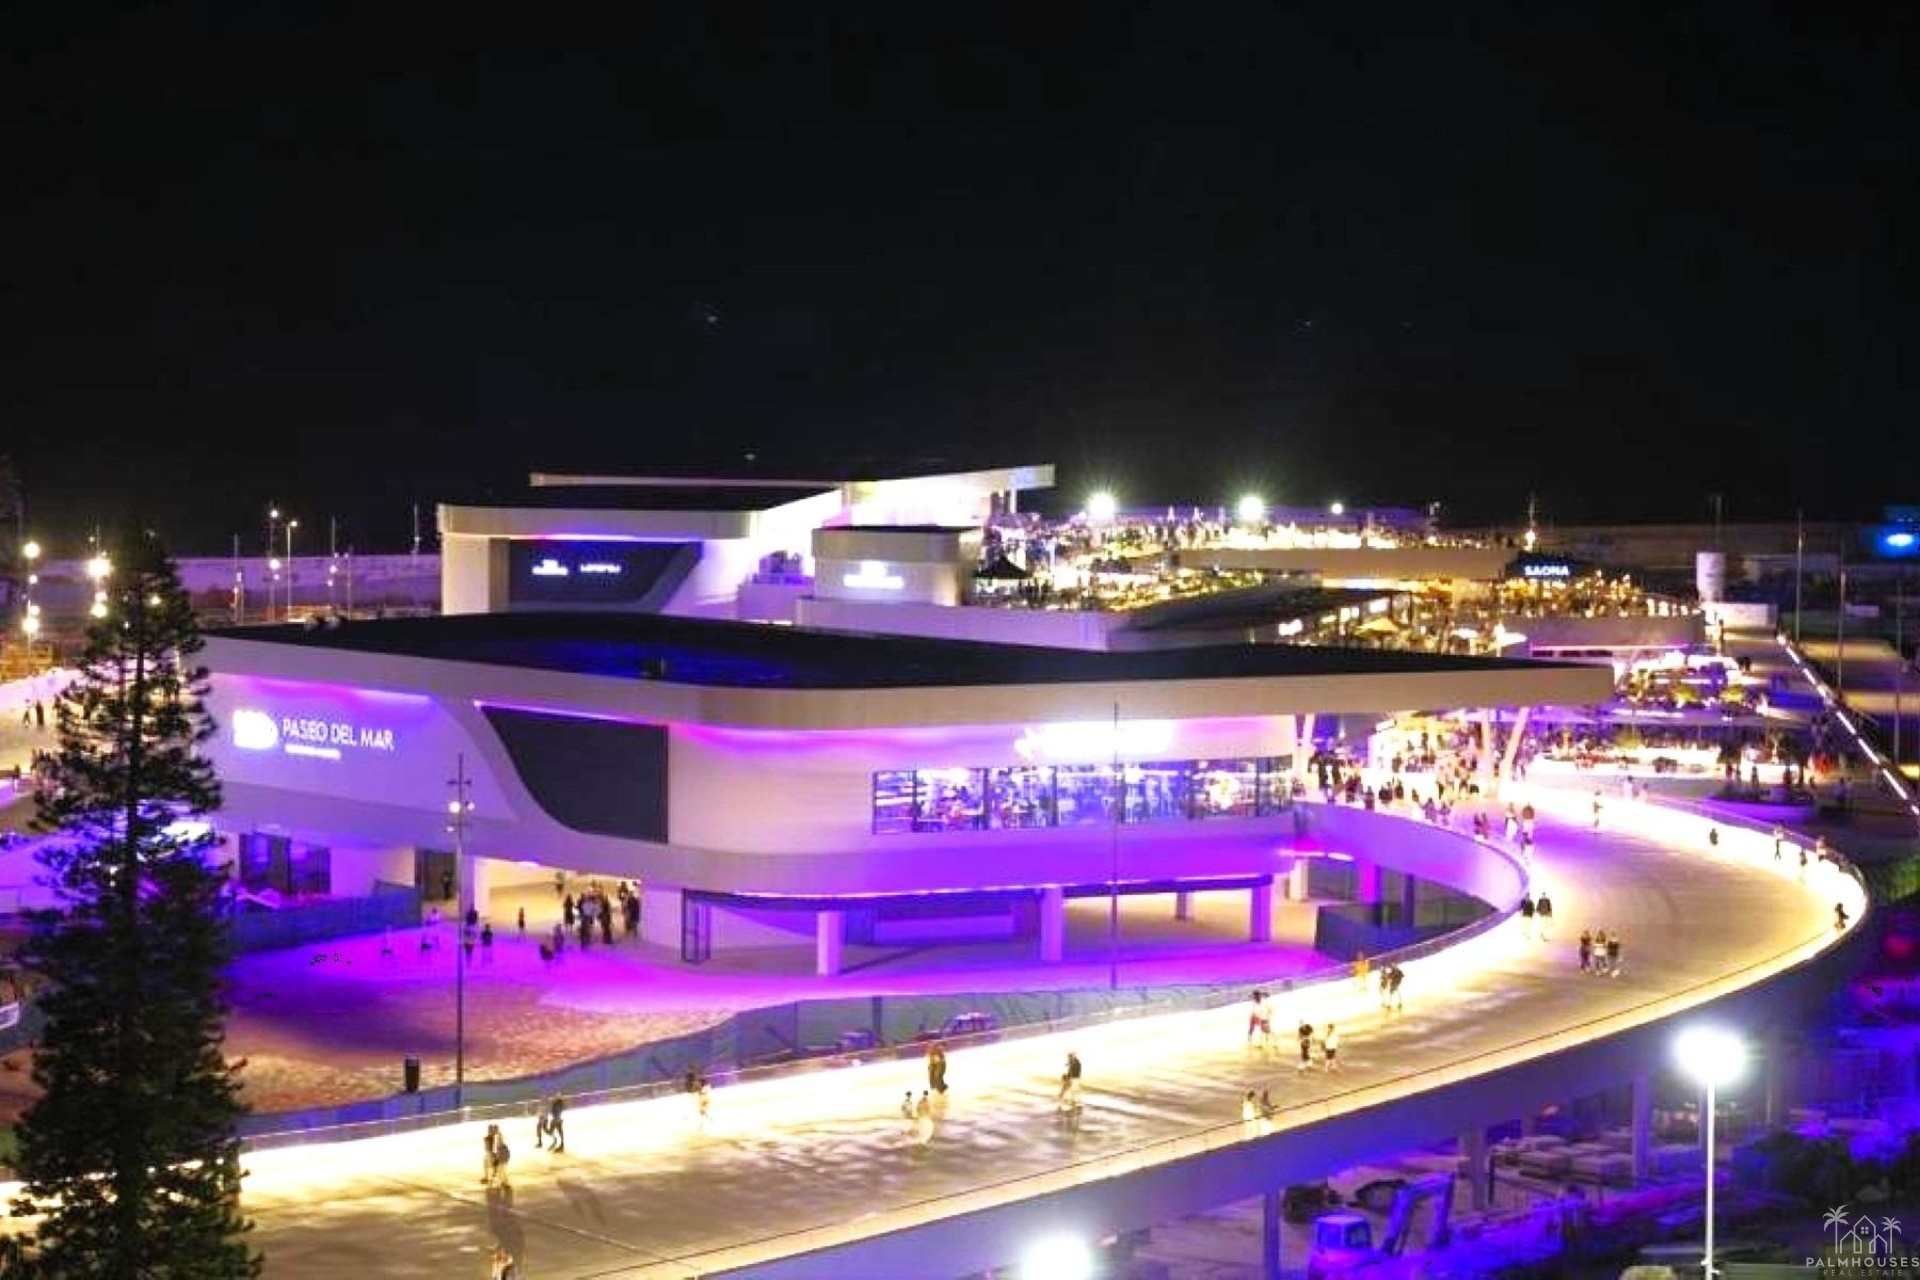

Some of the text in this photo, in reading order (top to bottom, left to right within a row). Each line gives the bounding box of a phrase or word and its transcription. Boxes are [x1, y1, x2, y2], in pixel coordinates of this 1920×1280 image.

[283, 717, 396, 751] PASEO DEL MAR
